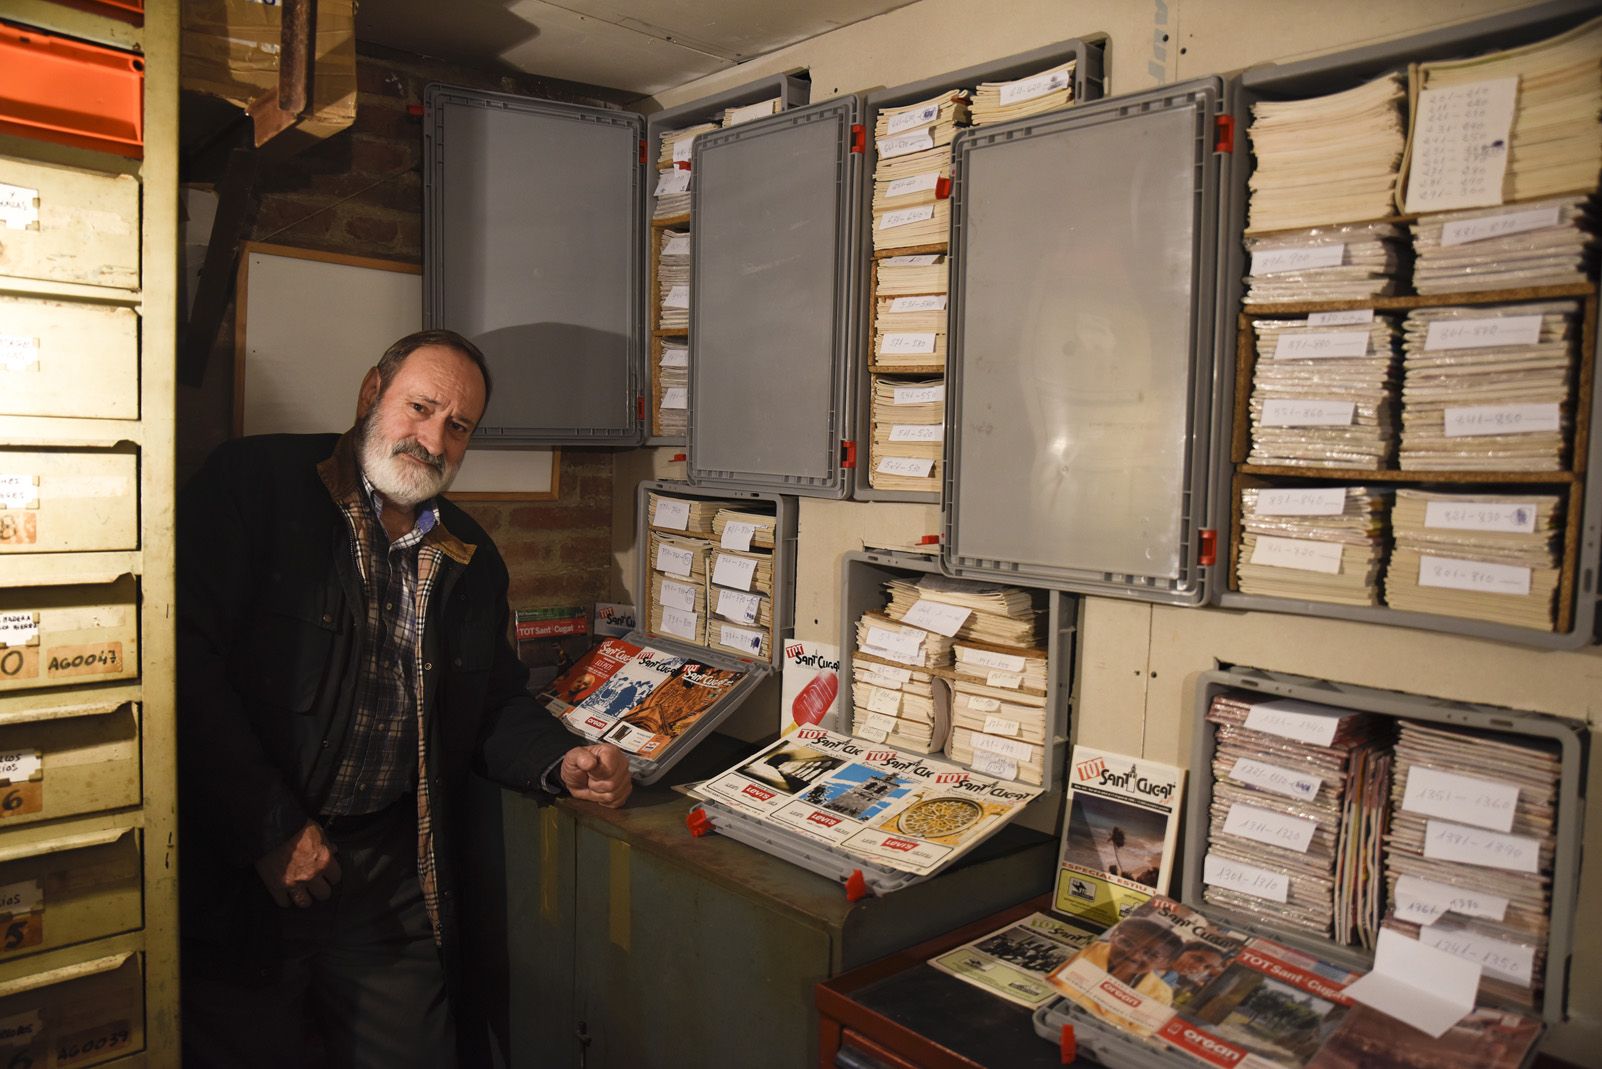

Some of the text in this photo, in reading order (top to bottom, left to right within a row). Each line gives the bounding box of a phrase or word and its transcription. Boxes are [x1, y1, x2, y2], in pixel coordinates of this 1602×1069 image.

[519, 624, 574, 636] TOT Sant Cugat
[797, 729, 829, 740] TOT
[865, 751, 897, 761] TOT
[1077, 757, 1105, 781] TOT
[936, 773, 969, 784] TOT
[1062, 862, 1148, 892] ESPECIAL ESTIU
[1152, 899, 1178, 912] TOT
[1241, 952, 1347, 1002] TOT Sant Cugat
[1102, 982, 1138, 1006] organ
[1184, 1029, 1240, 1061] organ
